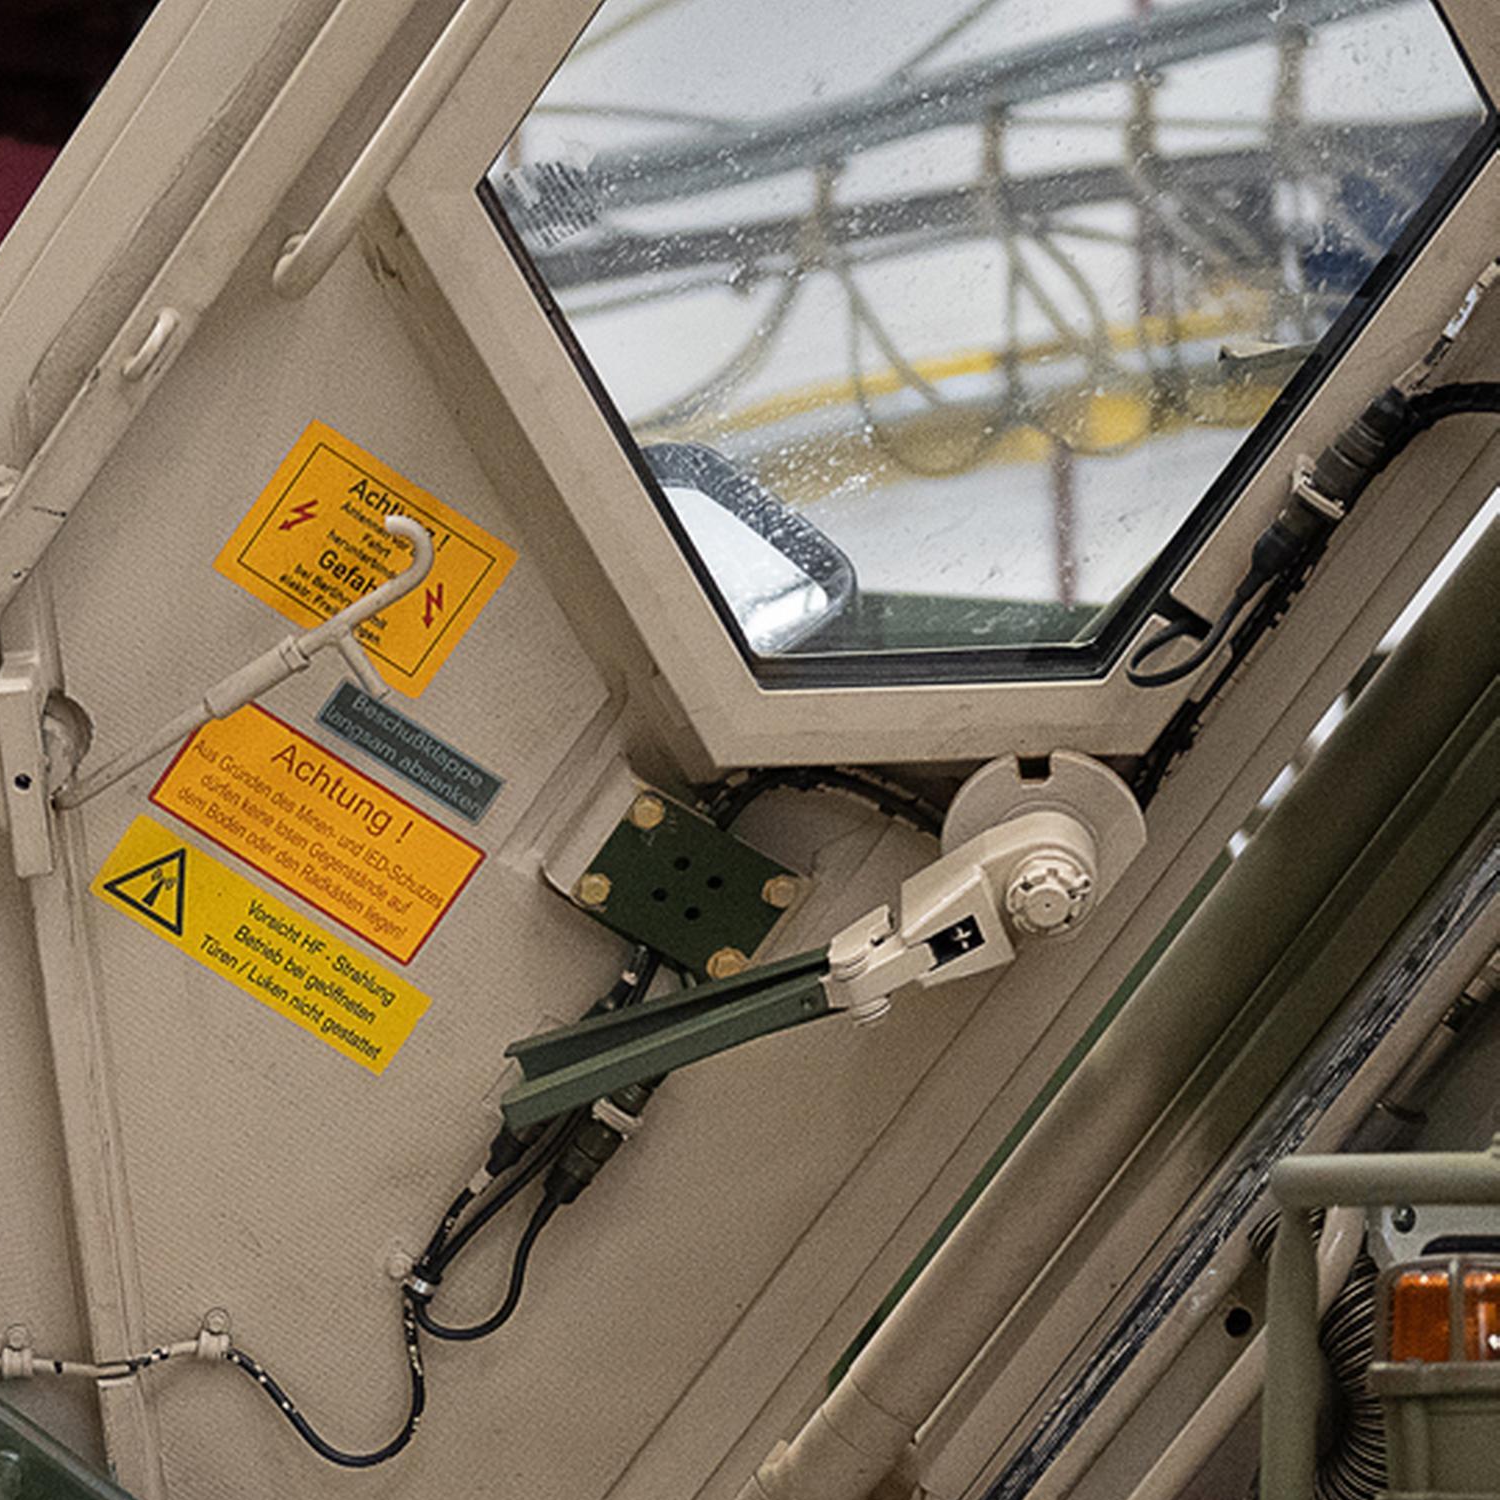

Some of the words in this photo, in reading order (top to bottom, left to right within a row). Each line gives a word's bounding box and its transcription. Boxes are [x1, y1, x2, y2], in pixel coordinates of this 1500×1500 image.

[347, 478, 438, 538] Acht
[436, 533, 451, 552] !
[361, 532, 392, 559] Fahrt
[318, 549, 378, 596] Gefah
[191, 739, 219, 764] Aus
[218, 754, 273, 799] Gründen
[270, 790, 297, 814] des
[336, 834, 367, 858] und
[270, 743, 393, 838] Achtung
[395, 820, 414, 844] !
[325, 705, 397, 762] langsam
[397, 756, 484, 818] absenken
[177, 786, 208, 813] dem
[203, 802, 248, 839] Boden
[244, 831, 277, 856] oder
[274, 850, 301, 874] den
[200, 774, 242, 807] dürfen
[239, 796, 275, 828] keine
[308, 841, 389, 903] Gegenstände
[386, 895, 414, 915] auf
[200, 933, 239, 970] Türen
[246, 964, 289, 1002] Luken
[288, 995, 325, 1024] nicht
[320, 1017, 383, 1061] gestattet
[233, 924, 284, 966] Betrieb
[303, 974, 377, 1025] geöffneten
[247, 899, 303, 945] Vorsicht
[299, 933, 327, 955] HF
[331, 954, 397, 1008] Strahlung
